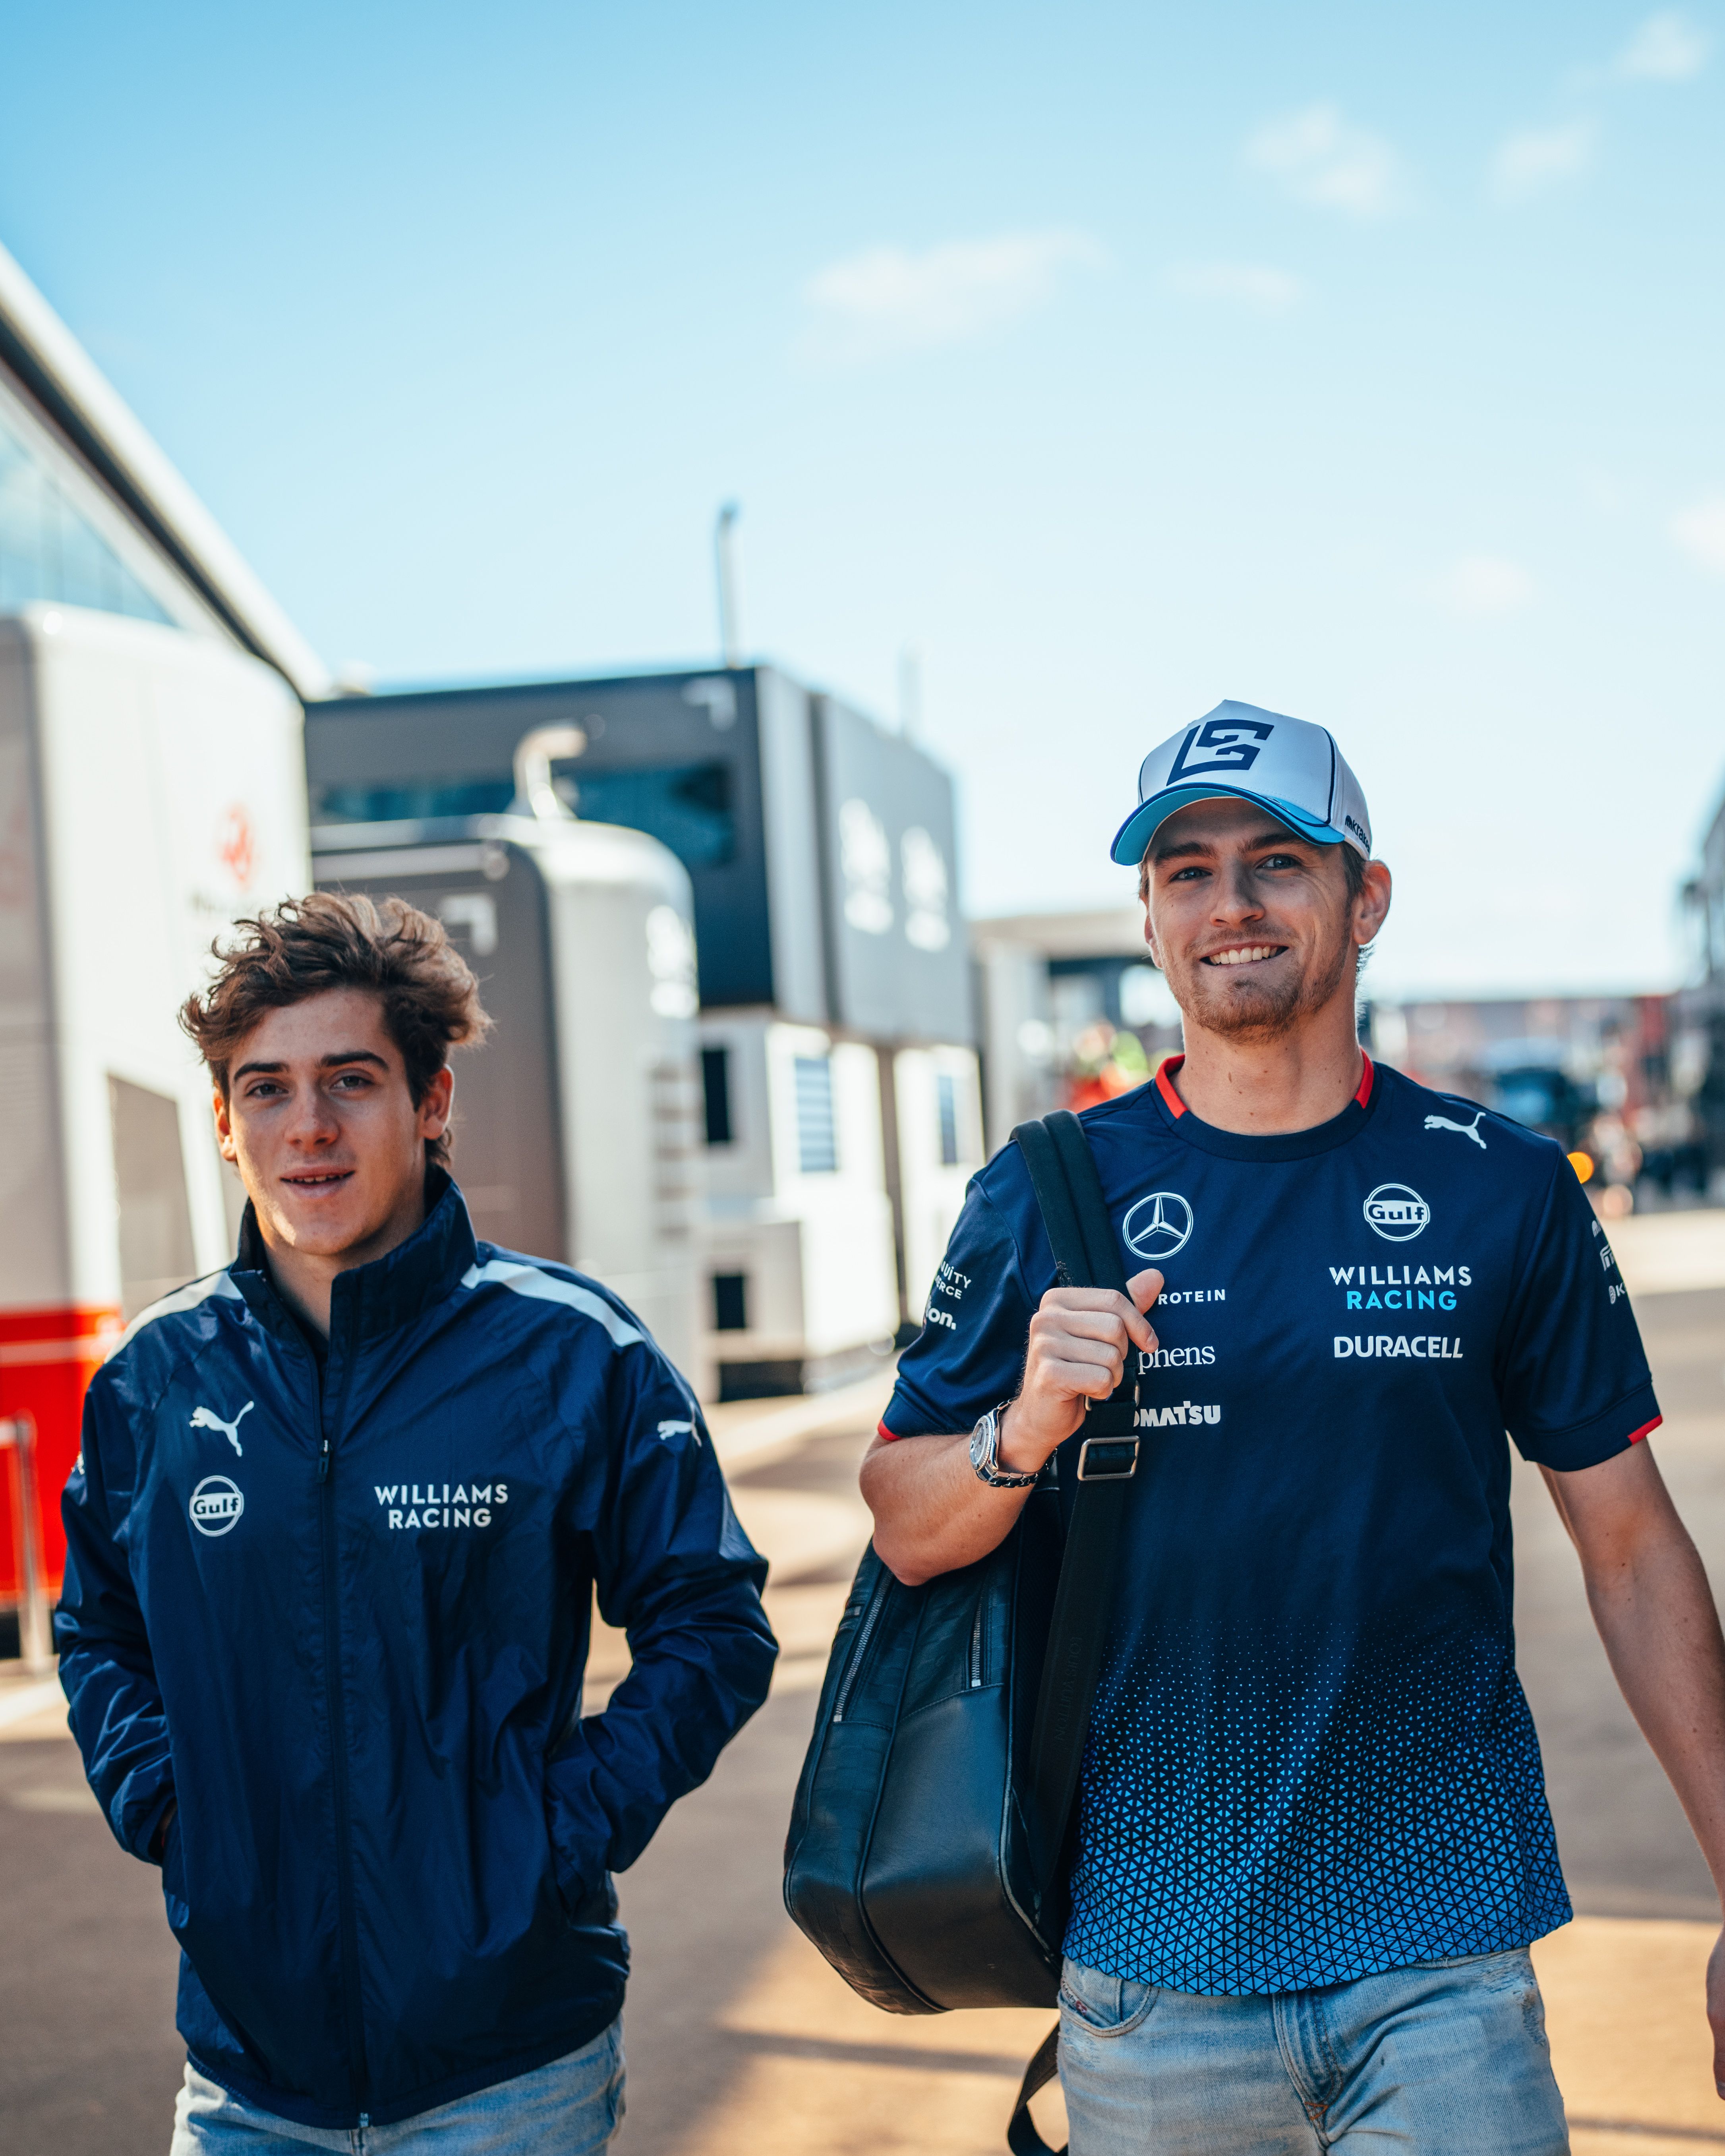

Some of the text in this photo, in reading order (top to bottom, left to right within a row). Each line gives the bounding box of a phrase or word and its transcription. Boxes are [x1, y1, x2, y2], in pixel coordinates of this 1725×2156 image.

[1368, 1204, 1424, 1220] Gulf
[1329, 1265, 1472, 1286] WILLIAMS
[1158, 1289, 1226, 1305] ROTEIN
[1347, 1290, 1457, 1310] RACING
[1334, 1336, 1463, 1358] DURACELL
[1138, 1346, 1216, 1375] phens
[374, 1484, 509, 1506] WILLIAMS
[193, 1497, 239, 1515] Gulf
[388, 1508, 492, 1530] RACING
